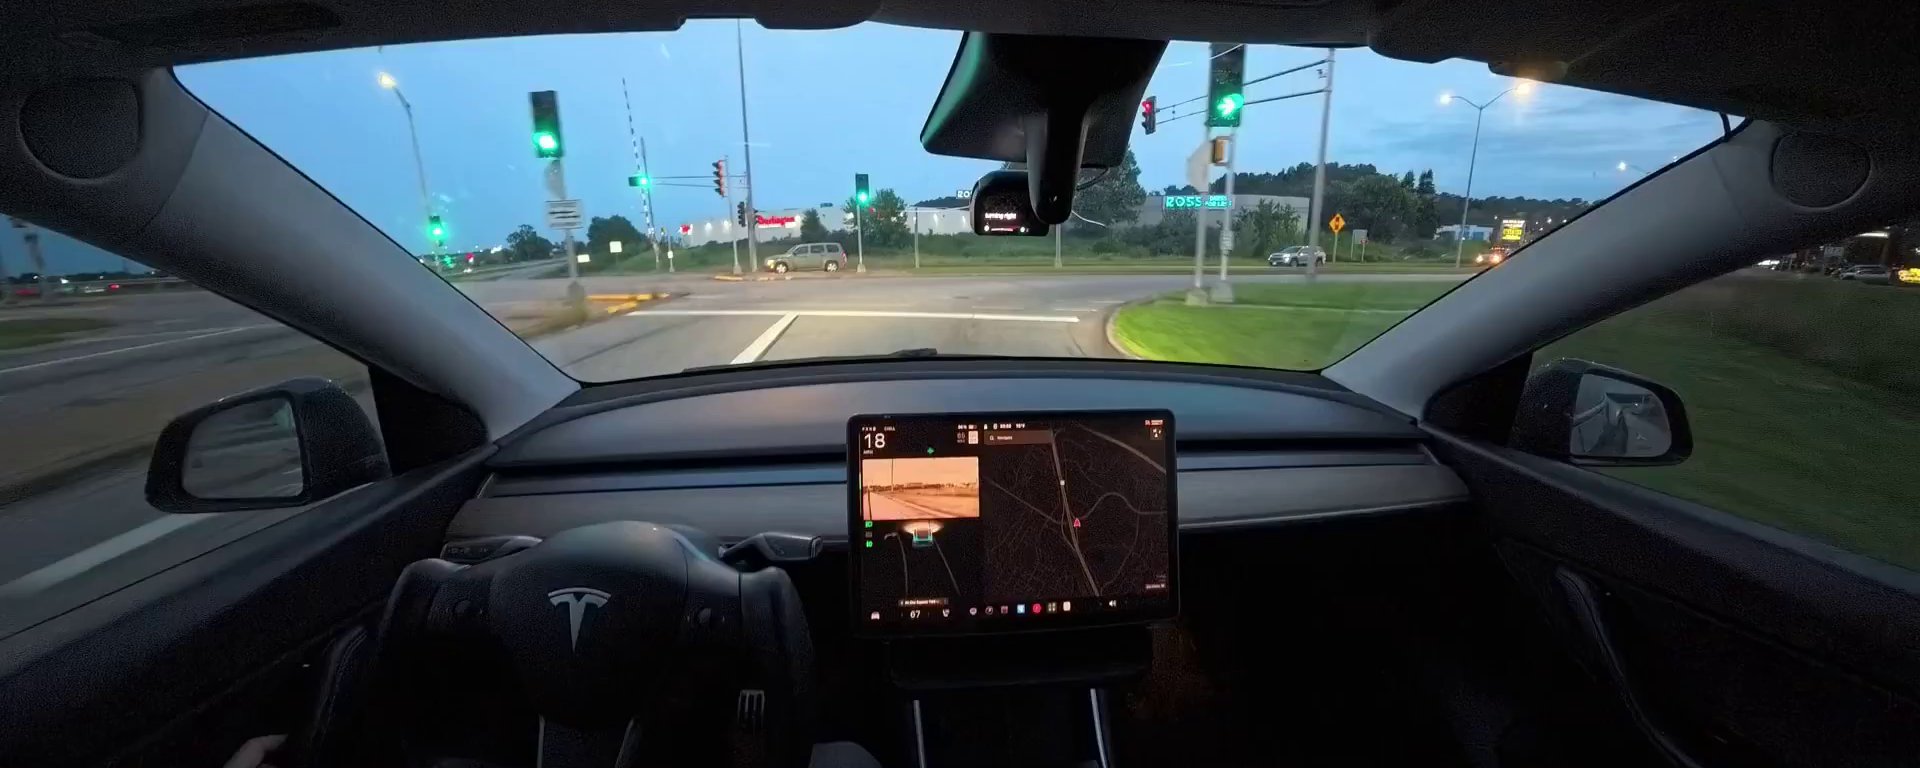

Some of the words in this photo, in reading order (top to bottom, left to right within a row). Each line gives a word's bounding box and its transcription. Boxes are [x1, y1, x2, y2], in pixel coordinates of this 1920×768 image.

[1166, 195, 1202, 208] ROSS
[1004, 212, 1017, 220] right
[864, 432, 886, 449] 18
